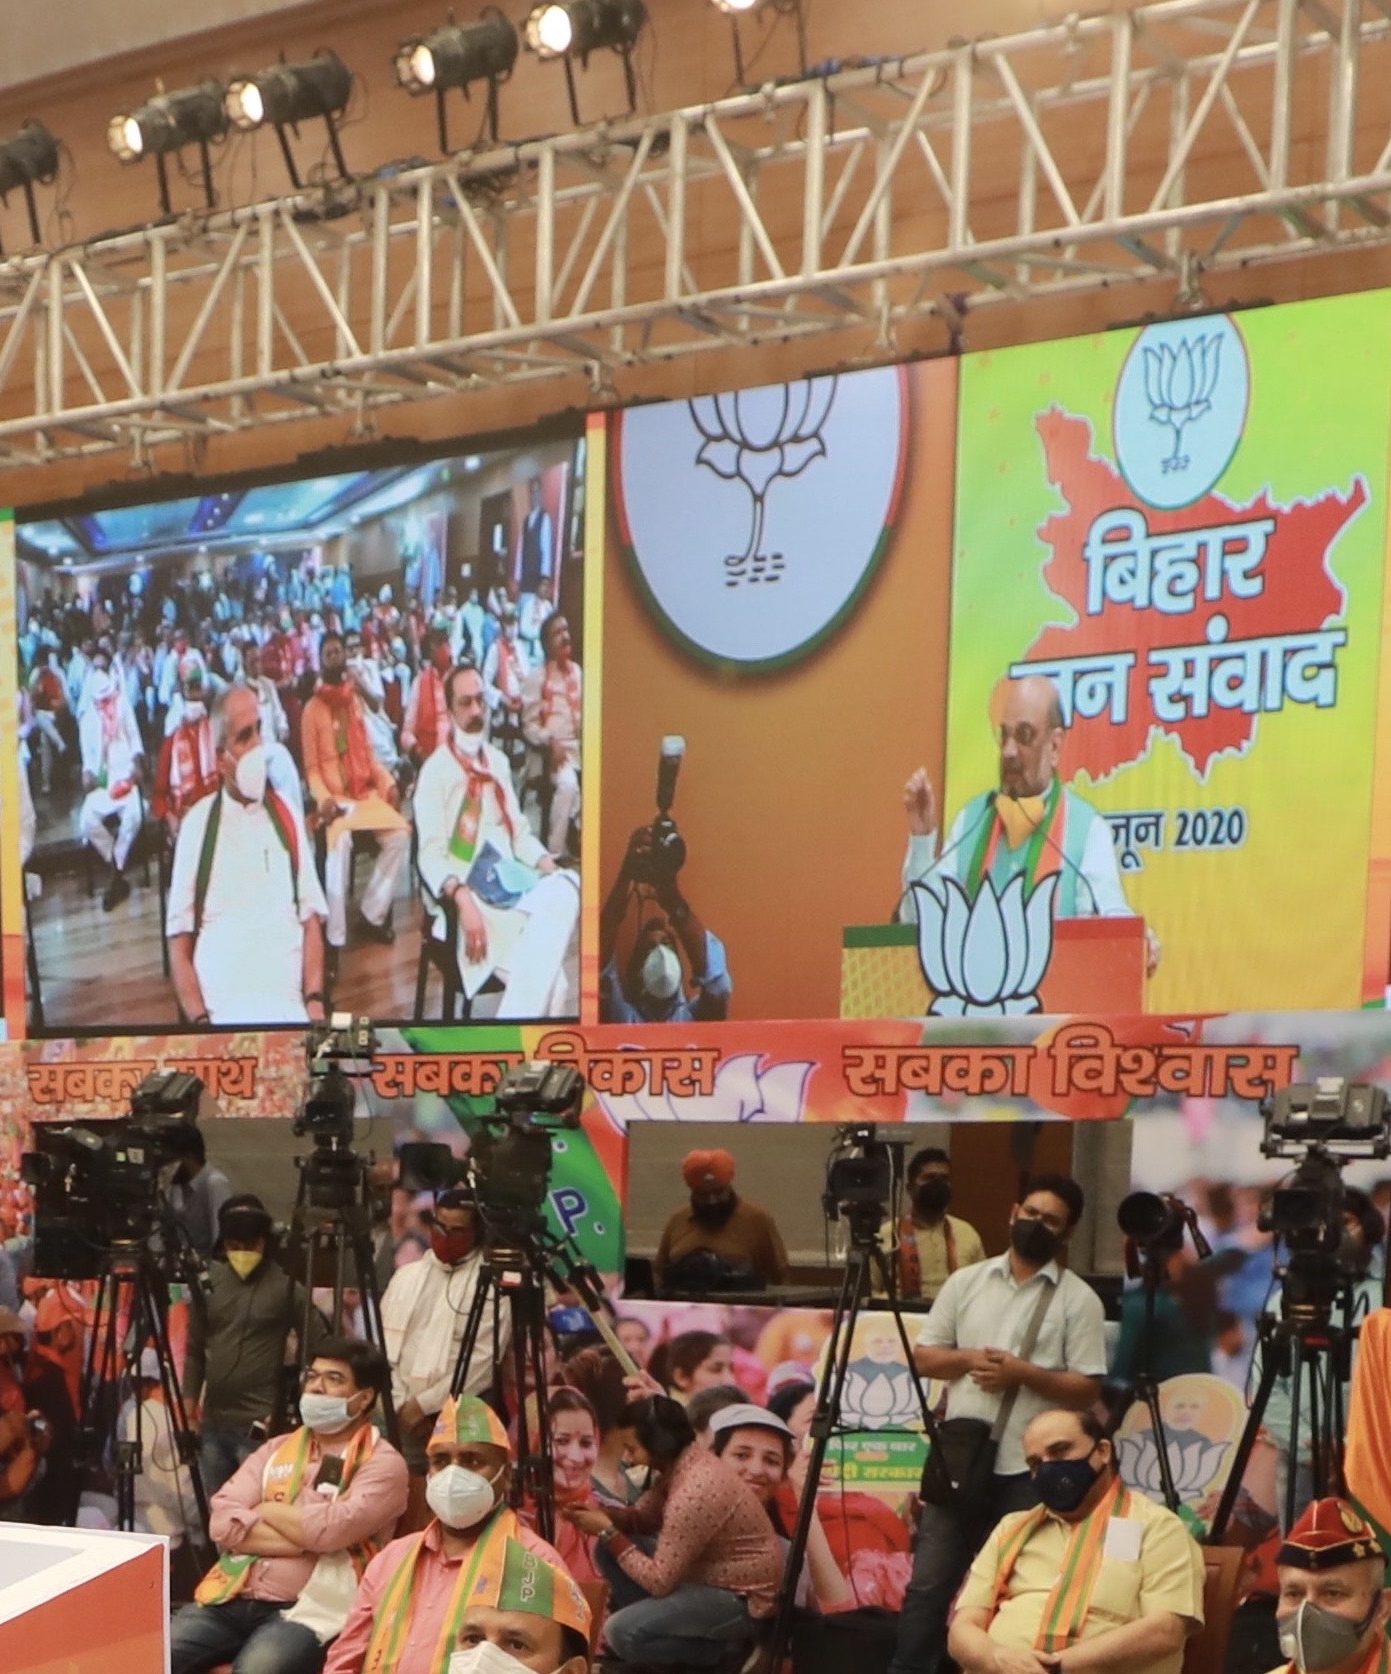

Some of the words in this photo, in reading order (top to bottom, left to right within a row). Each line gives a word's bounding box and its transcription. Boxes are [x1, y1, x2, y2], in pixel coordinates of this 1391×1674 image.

[1083, 508, 1276, 616] बिहार
[1147, 613, 1348, 724] संवाद
[1174, 807, 1245, 848] 2020
[842, 1045, 1037, 1097] सबका
[1050, 1023, 1300, 1100] विश्वास
